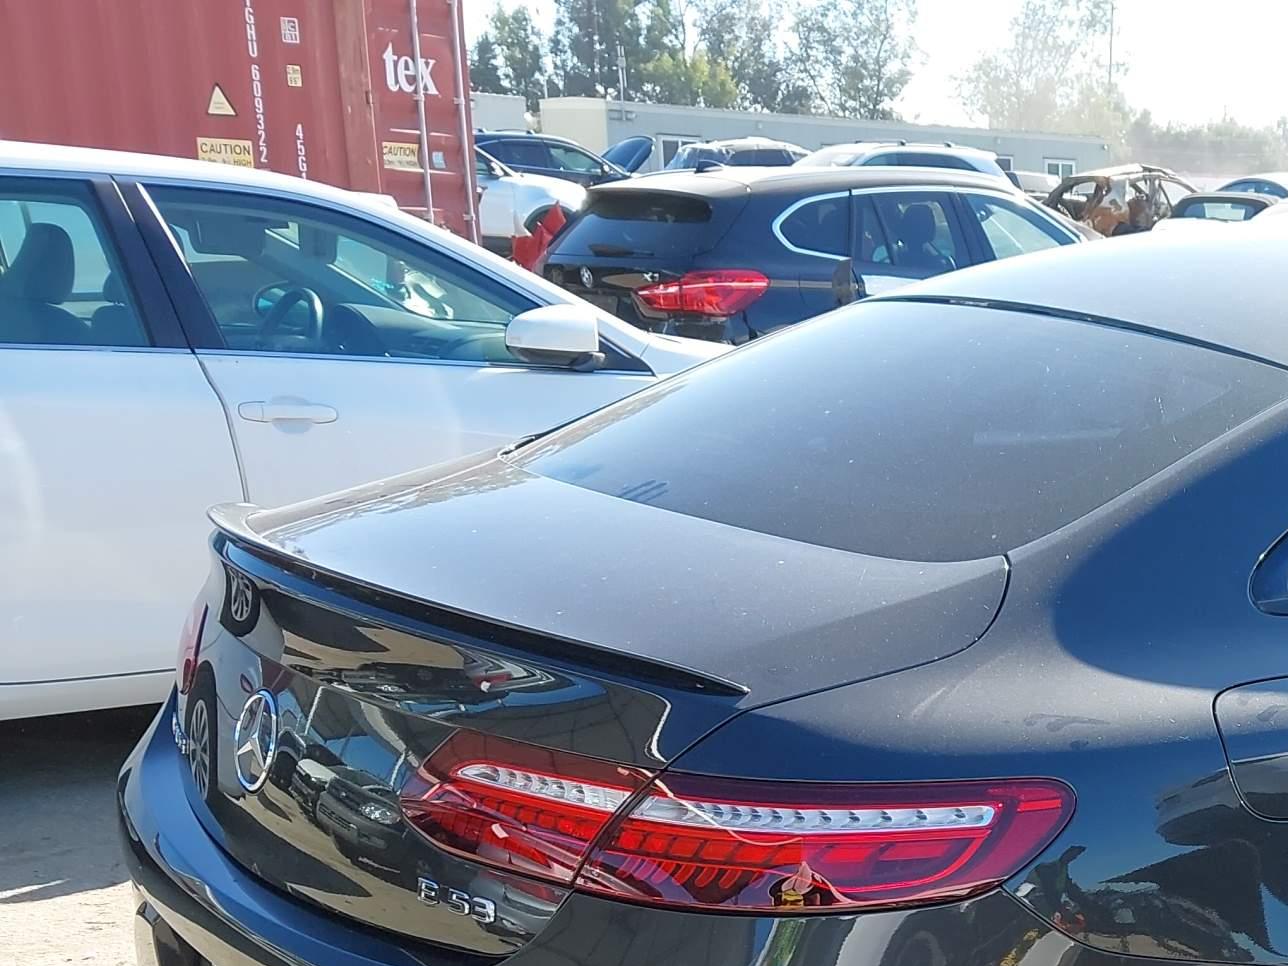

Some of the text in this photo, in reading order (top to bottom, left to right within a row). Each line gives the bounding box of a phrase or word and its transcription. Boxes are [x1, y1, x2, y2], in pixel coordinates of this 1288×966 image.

[383, 42, 439, 94] tex
[251, 64, 268, 163] 609322
[200, 142, 251, 156] CAUTION
[383, 145, 416, 157] CAUTION
[417, 877, 496, 924] E 53
